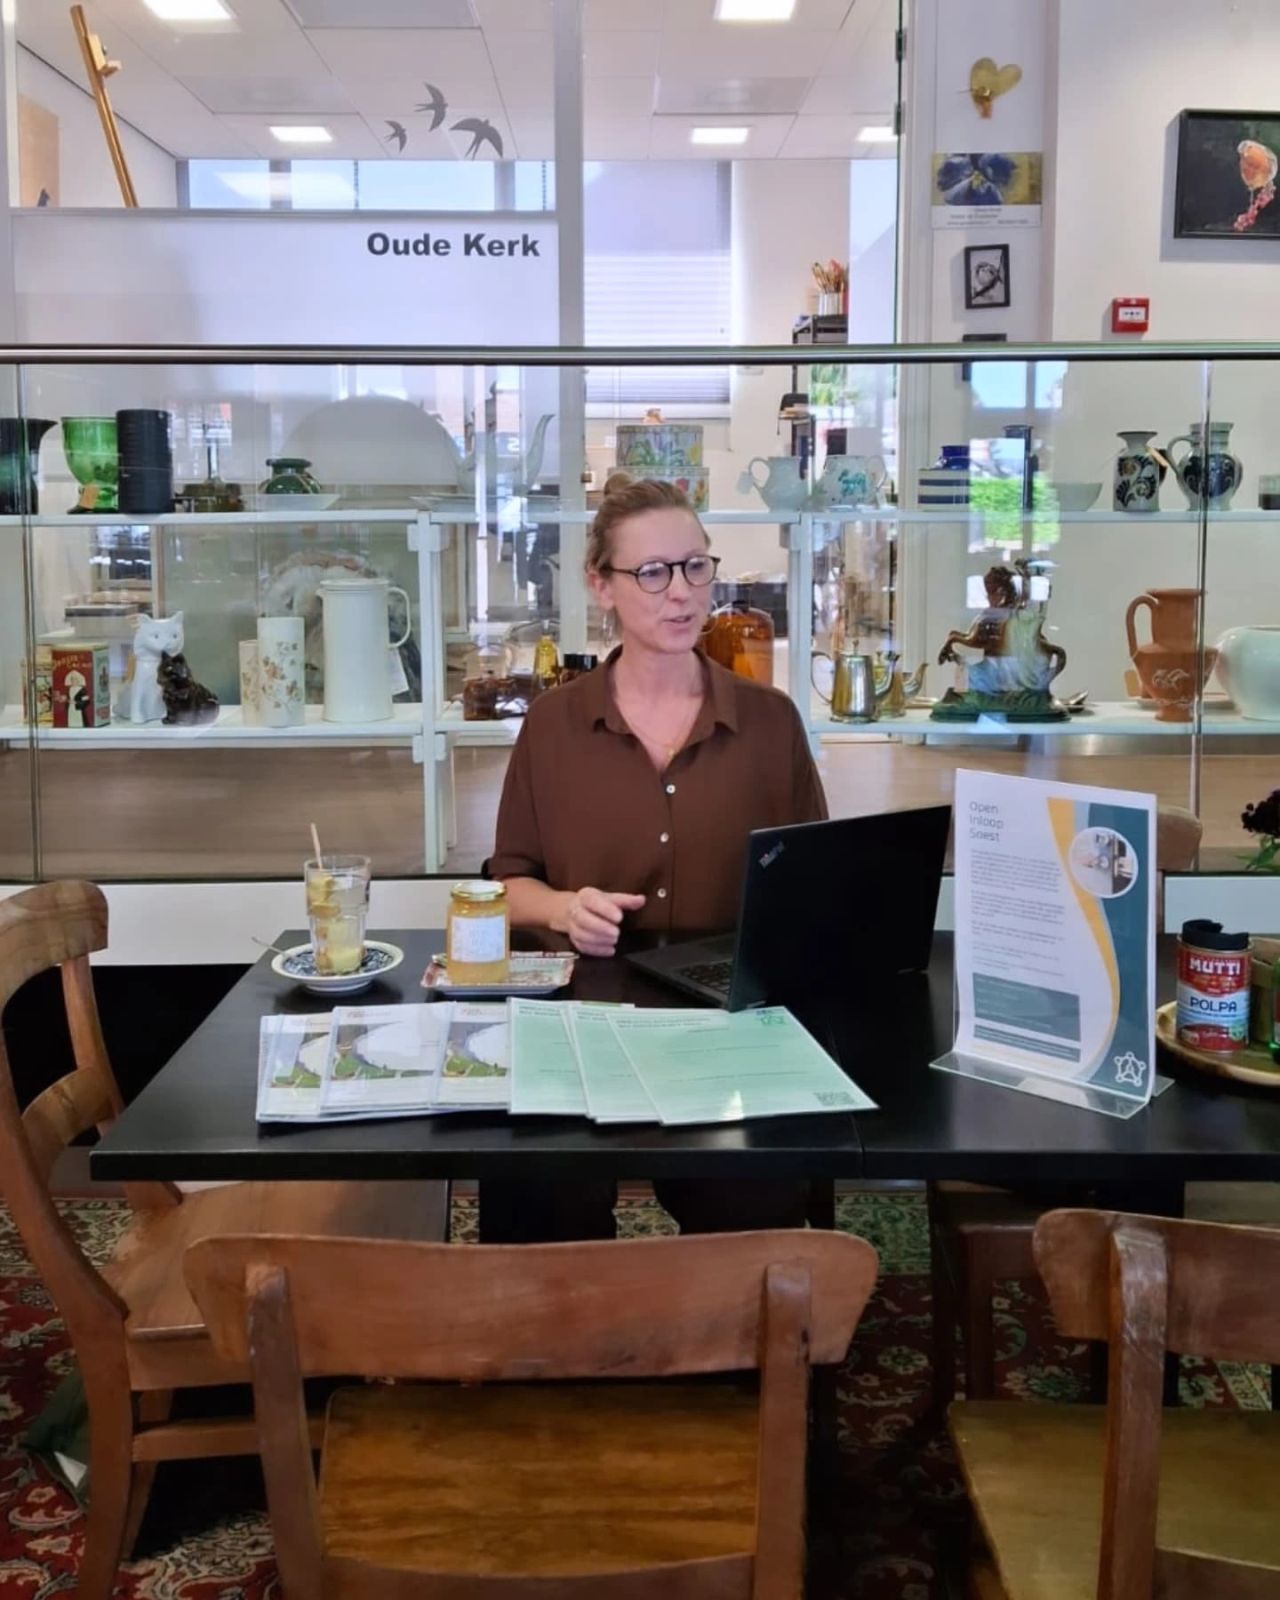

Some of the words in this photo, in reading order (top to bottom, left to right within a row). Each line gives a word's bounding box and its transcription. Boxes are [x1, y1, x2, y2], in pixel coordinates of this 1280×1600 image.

[367, 232, 451, 256] Oude
[464, 233, 540, 257] Kerk
[969, 801, 999, 815] Open
[969, 814, 1004, 830] Inloop
[969, 827, 1000, 842] Soest
[1189, 957, 1241, 975] MUTTI
[1190, 996, 1238, 1013] POLPA
